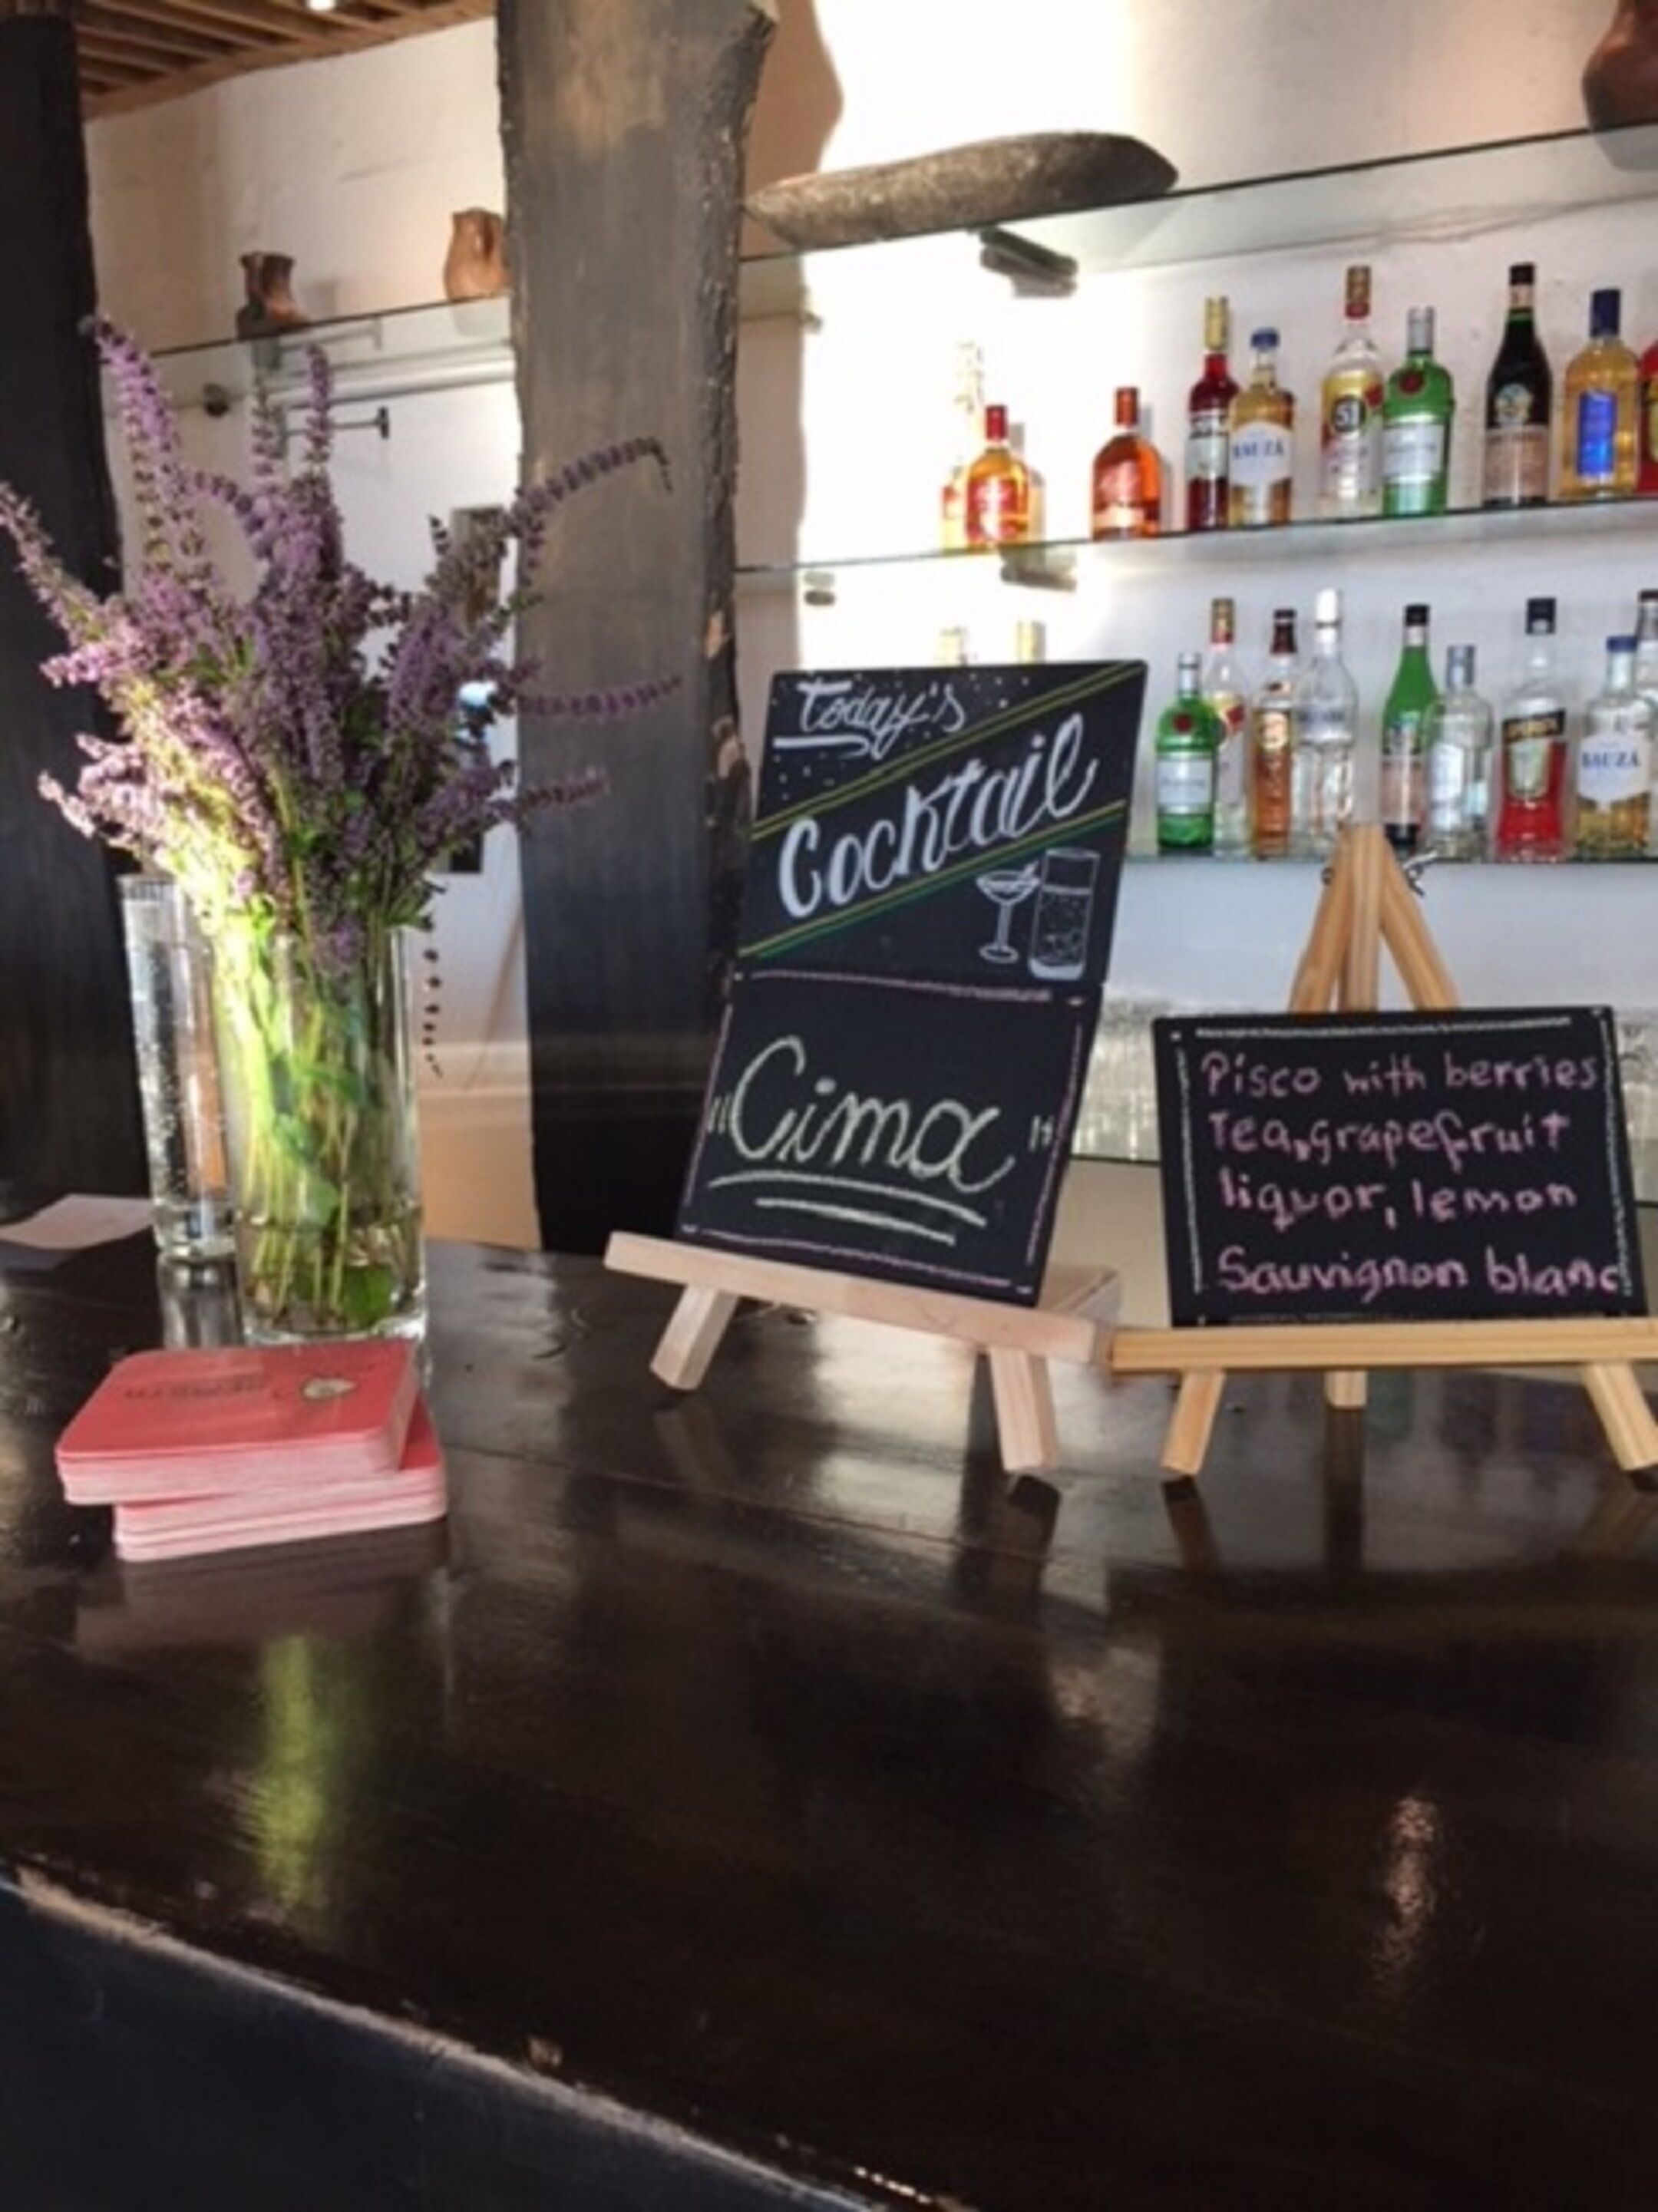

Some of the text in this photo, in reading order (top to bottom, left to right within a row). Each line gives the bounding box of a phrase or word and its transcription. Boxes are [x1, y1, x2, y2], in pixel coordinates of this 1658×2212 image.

[796, 680, 965, 760] Today's
[778, 713, 1098, 918] Cocktail
[1201, 1051, 1597, 1098] Pisco with berries
[1218, 1167, 1578, 1230] liquor, lemon
[1218, 1246, 1620, 1305] Sauvignon blanc
